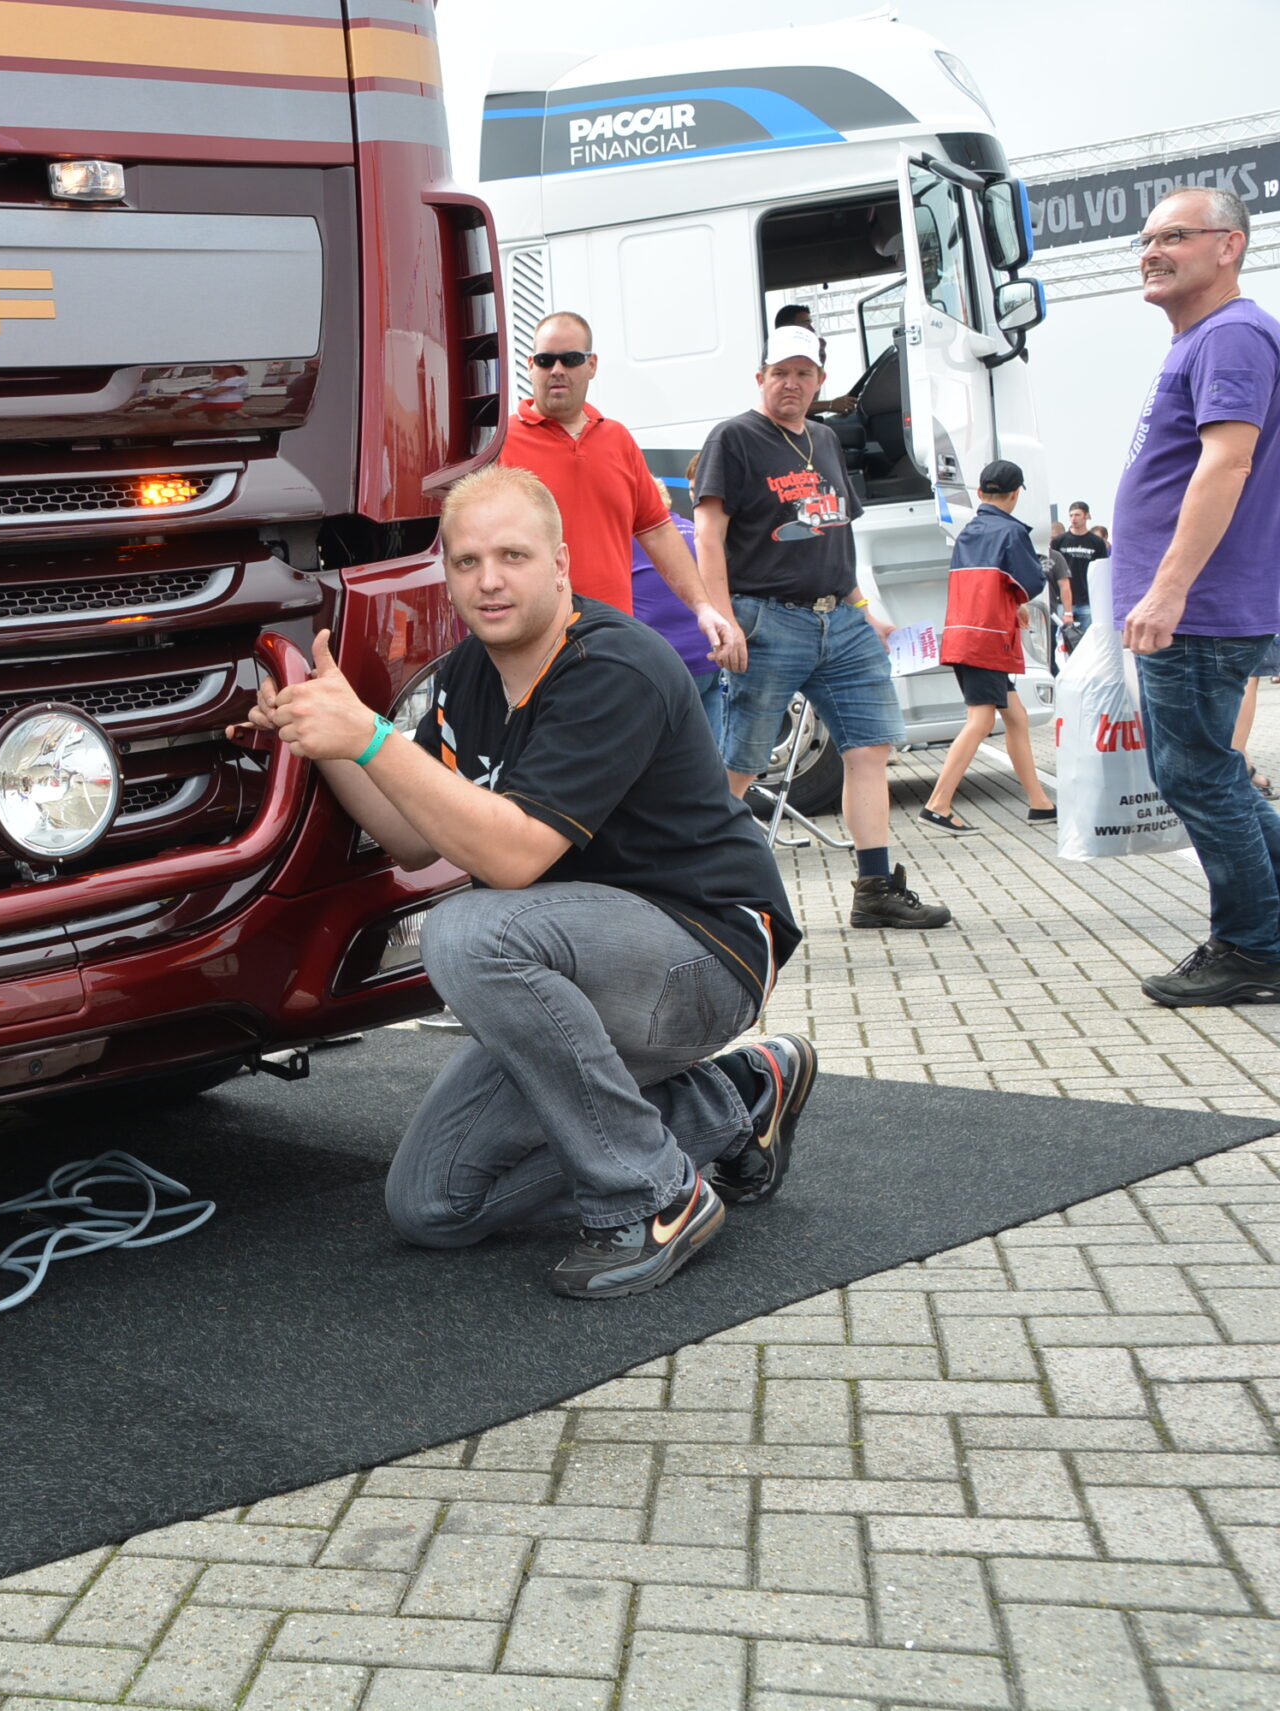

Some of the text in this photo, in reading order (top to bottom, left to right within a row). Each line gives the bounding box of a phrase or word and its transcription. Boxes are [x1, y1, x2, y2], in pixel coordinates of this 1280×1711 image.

[569, 103, 697, 144] PACCAR
[569, 131, 697, 166] FINANCIAL
[1119, 790, 1163, 806] ABONN
